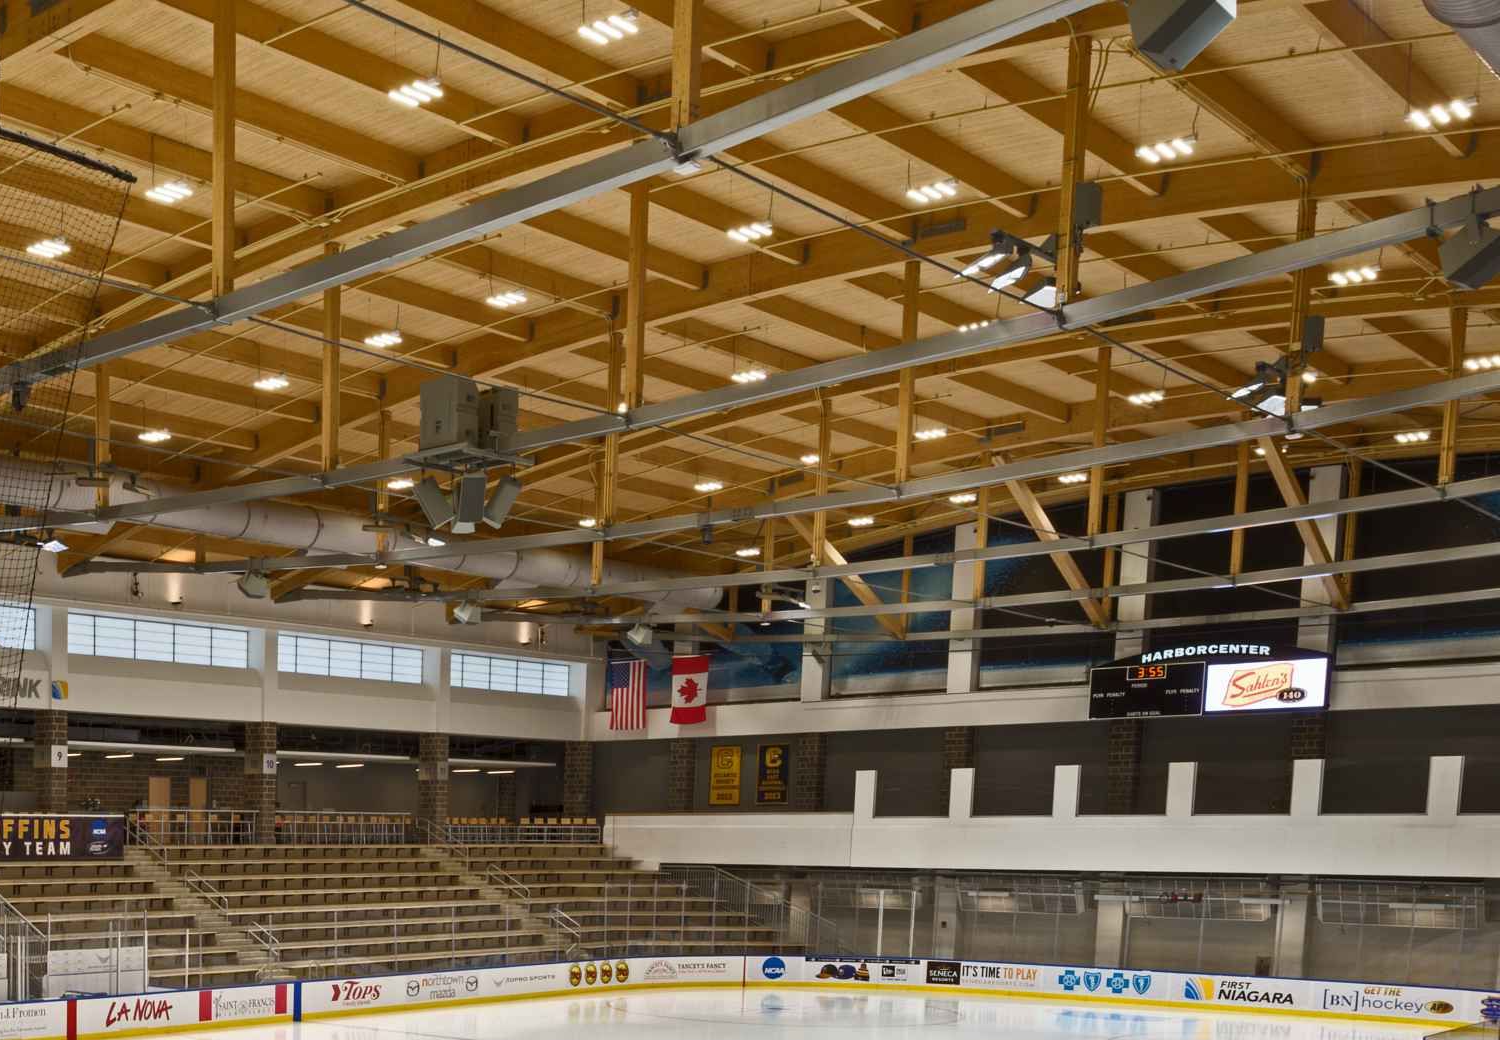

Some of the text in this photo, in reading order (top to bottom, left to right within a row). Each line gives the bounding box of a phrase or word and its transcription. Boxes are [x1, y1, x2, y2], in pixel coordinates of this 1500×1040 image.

[1142, 644, 1270, 664] HARBORCENTER
[1231, 672, 1287, 698] Sahlen's
[57, 752, 62, 760] 9
[266, 759, 274, 769] 10
[24, 841, 71, 856] TEAM
[930, 970, 958, 978] SENECA
[962, 965, 1038, 981] IT'S TIME TO PLAY
[1220, 980, 1252, 991] FIRST
[1364, 987, 1402, 997] GET THE
[1218, 989, 1294, 1005] NIAGARA
[1361, 996, 1423, 1013] hockey
[12, 1007, 46, 1019] Fromen
[105, 998, 173, 1028] LA NOVA
